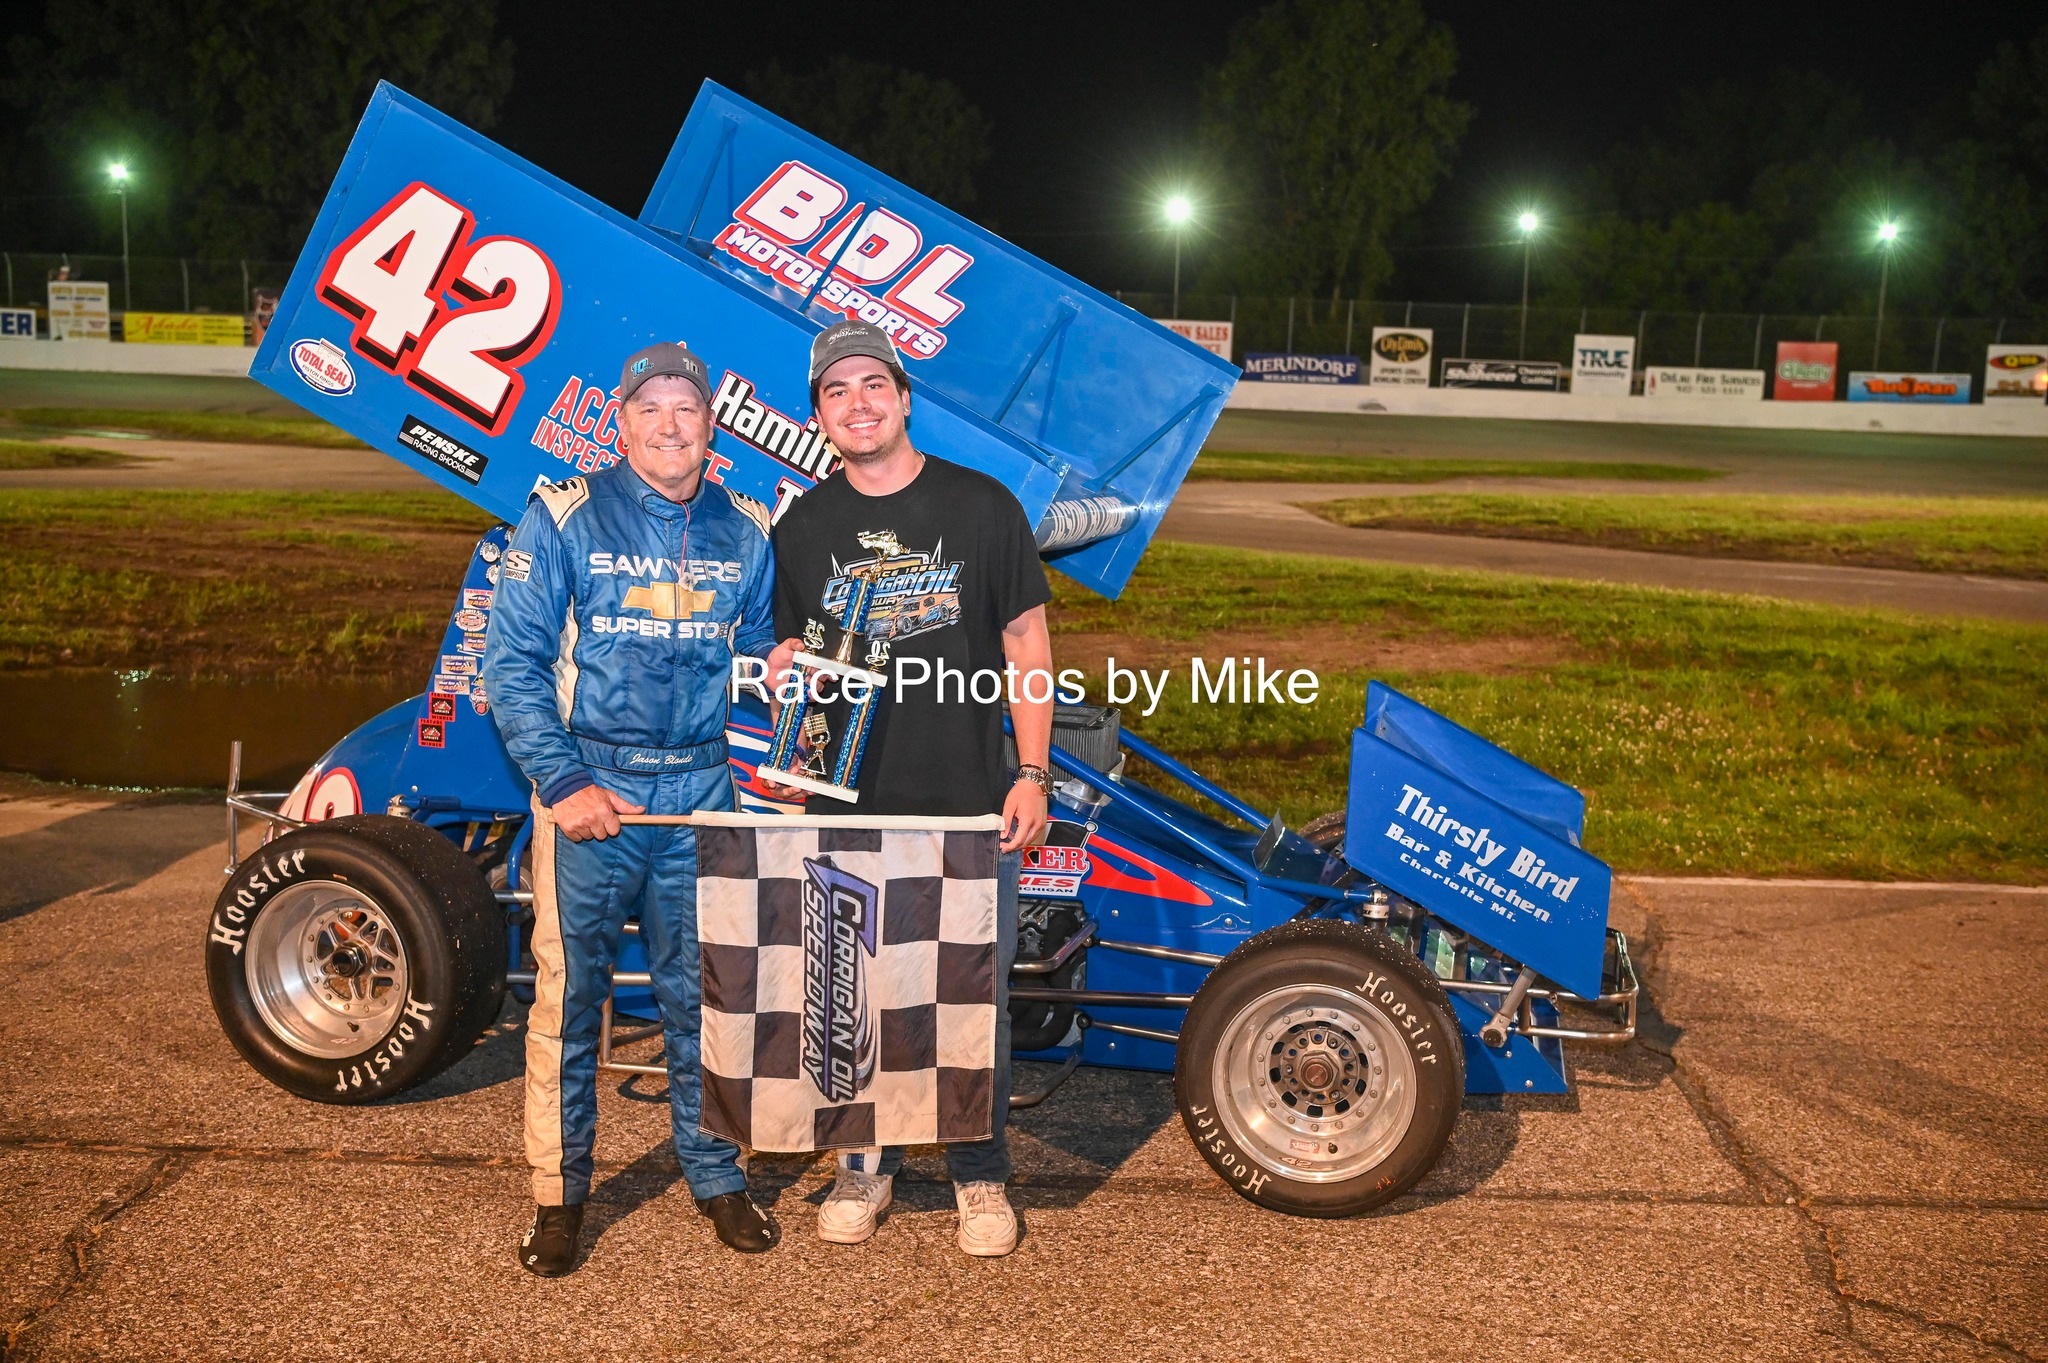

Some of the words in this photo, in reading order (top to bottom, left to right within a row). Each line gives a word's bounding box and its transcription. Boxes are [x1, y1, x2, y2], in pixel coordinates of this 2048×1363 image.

[733, 160, 974, 328] BDL
[315, 181, 562, 437] 42
[712, 223, 947, 360] MOTORSPORTS
[1196, 326, 1228, 341] SALES
[1578, 349, 1630, 369] TRUE
[298, 346, 325, 373] TOTAL
[324, 364, 348, 388] SEAL
[302, 364, 320, 379] PISTON
[1245, 356, 1357, 378] MERINDORF
[409, 424, 480, 468] PENSKE
[708, 368, 845, 484] Hamilt
[412, 439, 439, 459] RACING
[438, 454, 466, 474] SHOCKS
[589, 552, 742, 583] SAWYERS
[913, 563, 959, 597] OIL
[592, 615, 672, 639] SUPER
[629, 753, 660, 765] Jason
[1395, 783, 1508, 868] Thirsty
[1507, 846, 1581, 903] Bird
[1384, 822, 1431, 854] Bar
[1434, 849, 1453, 870] &
[1457, 861, 1552, 923] Kitchen
[1399, 852, 1485, 905] Charlotte
[211, 850, 306, 956] Hoosier
[804, 883, 827, 1088] SPEEDWAY
[831, 889, 863, 1051] CORRIGAN
[335, 989, 435, 1093] Hoosier
[1355, 971, 1438, 1065] Hoosier
[831, 1057, 854, 1101] OIL
[1192, 1104, 1273, 1196] Hoosier
